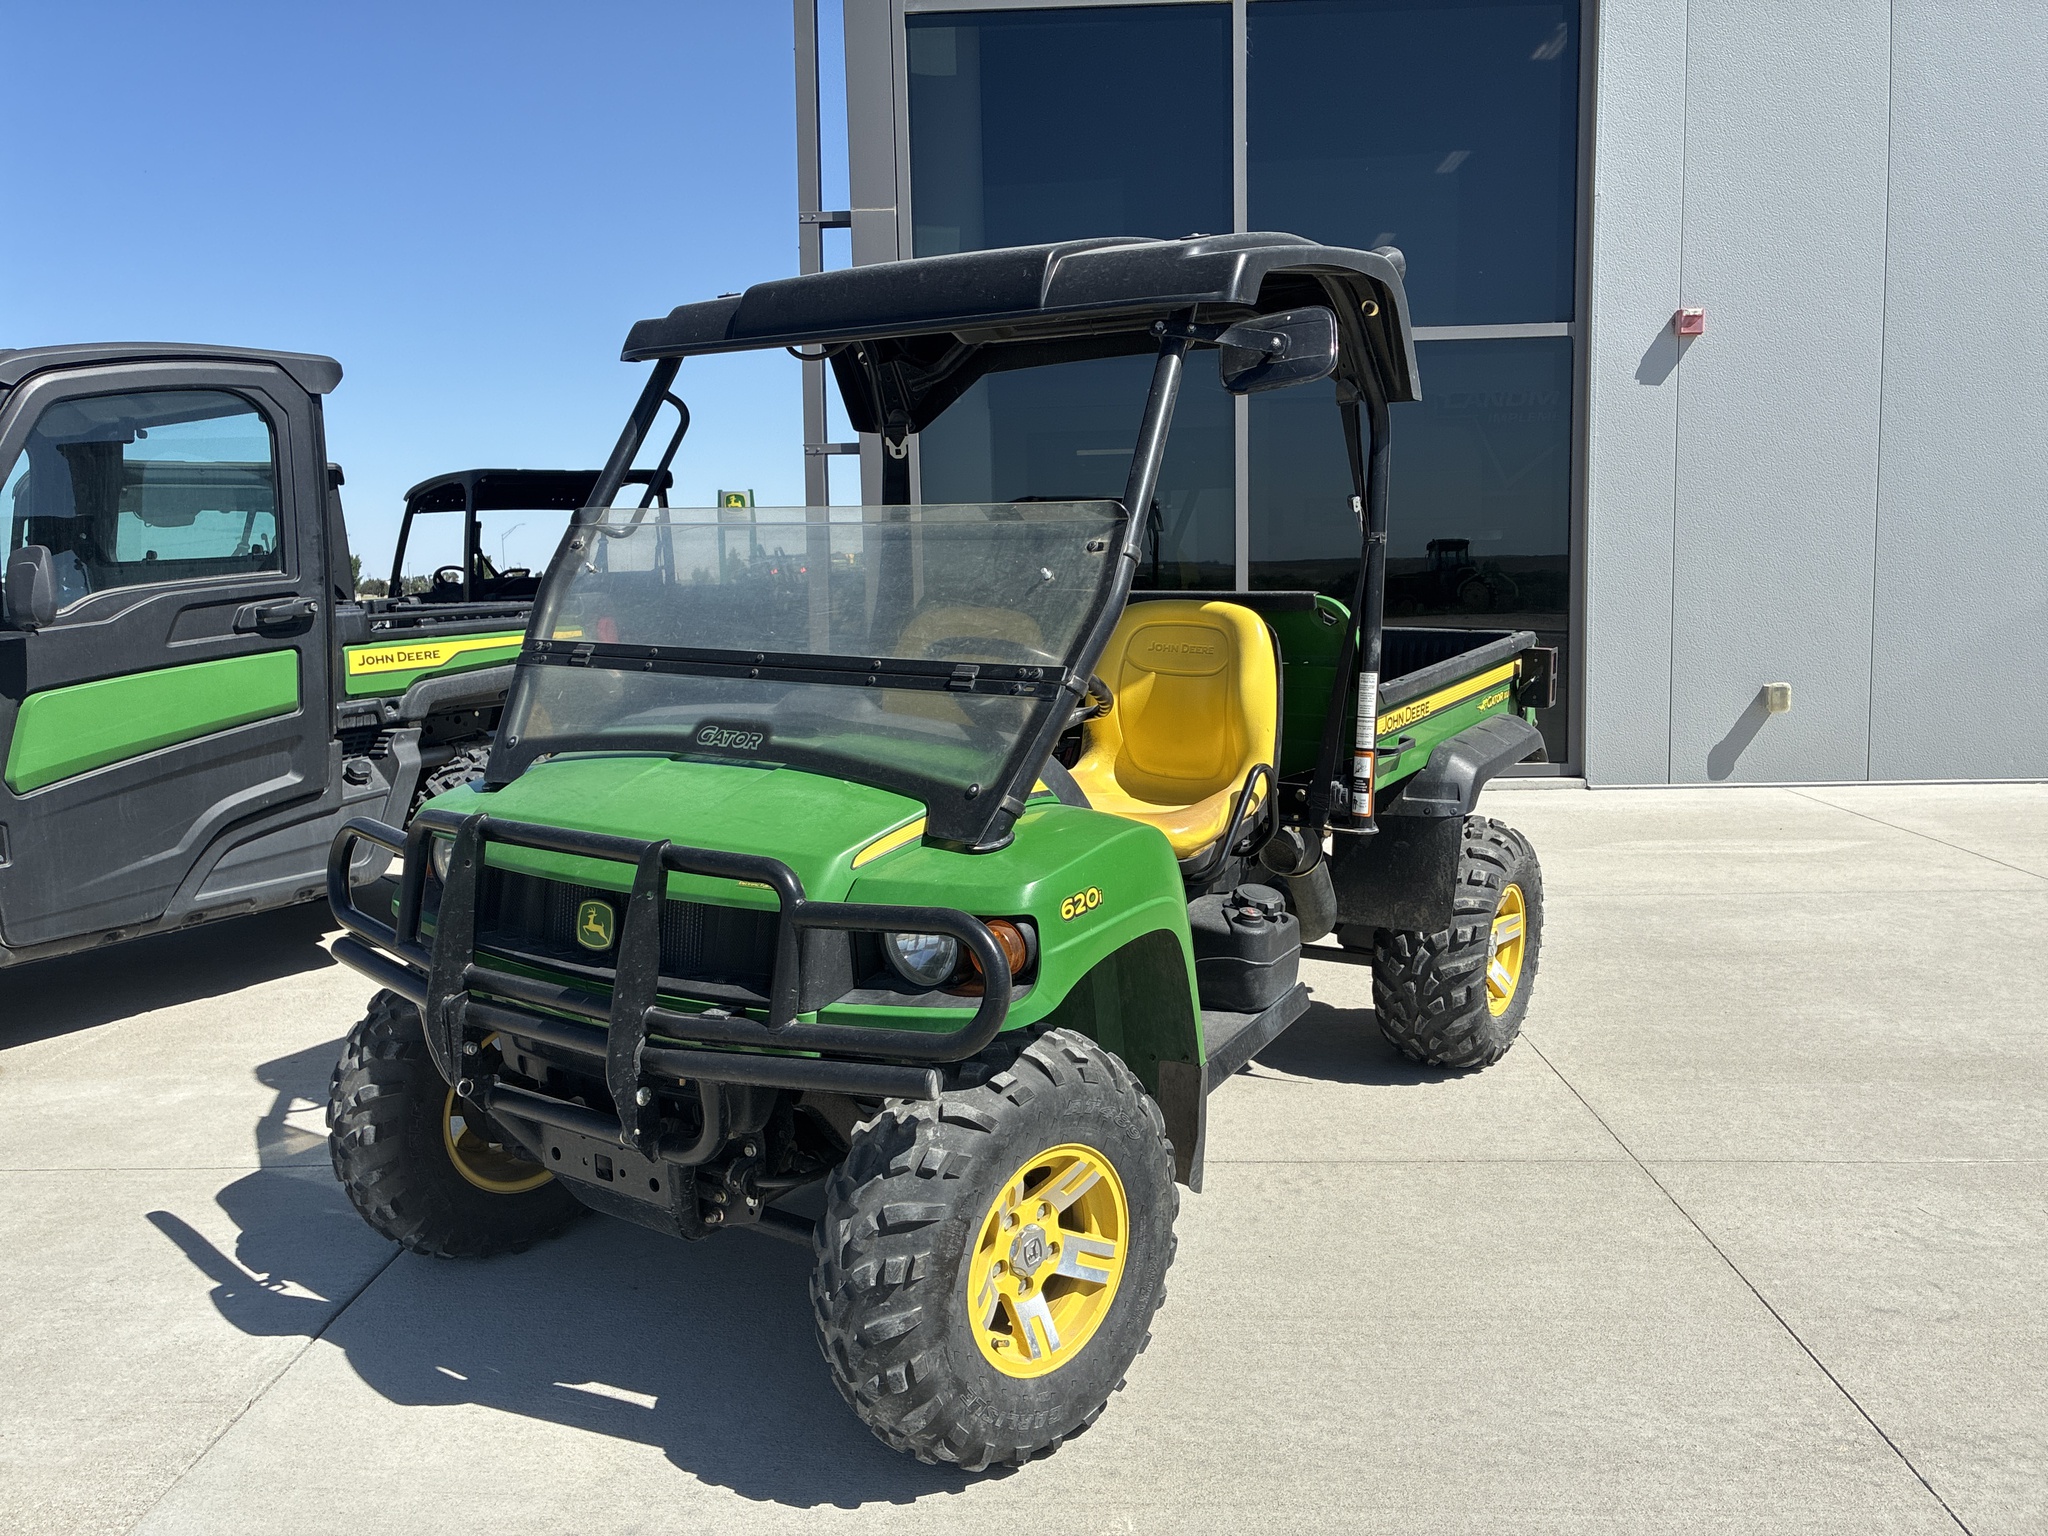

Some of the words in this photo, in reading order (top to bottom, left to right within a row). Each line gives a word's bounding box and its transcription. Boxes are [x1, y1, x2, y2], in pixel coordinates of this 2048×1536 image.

[358, 654, 395, 667] JOHN
[397, 650, 441, 663] DEERE
[1147, 641, 1179, 653] JOHN
[1181, 643, 1214, 655] DEERE
[1382, 711, 1404, 733] JOHN
[1405, 701, 1430, 723] DEERE
[696, 725, 764, 751] GATOR
